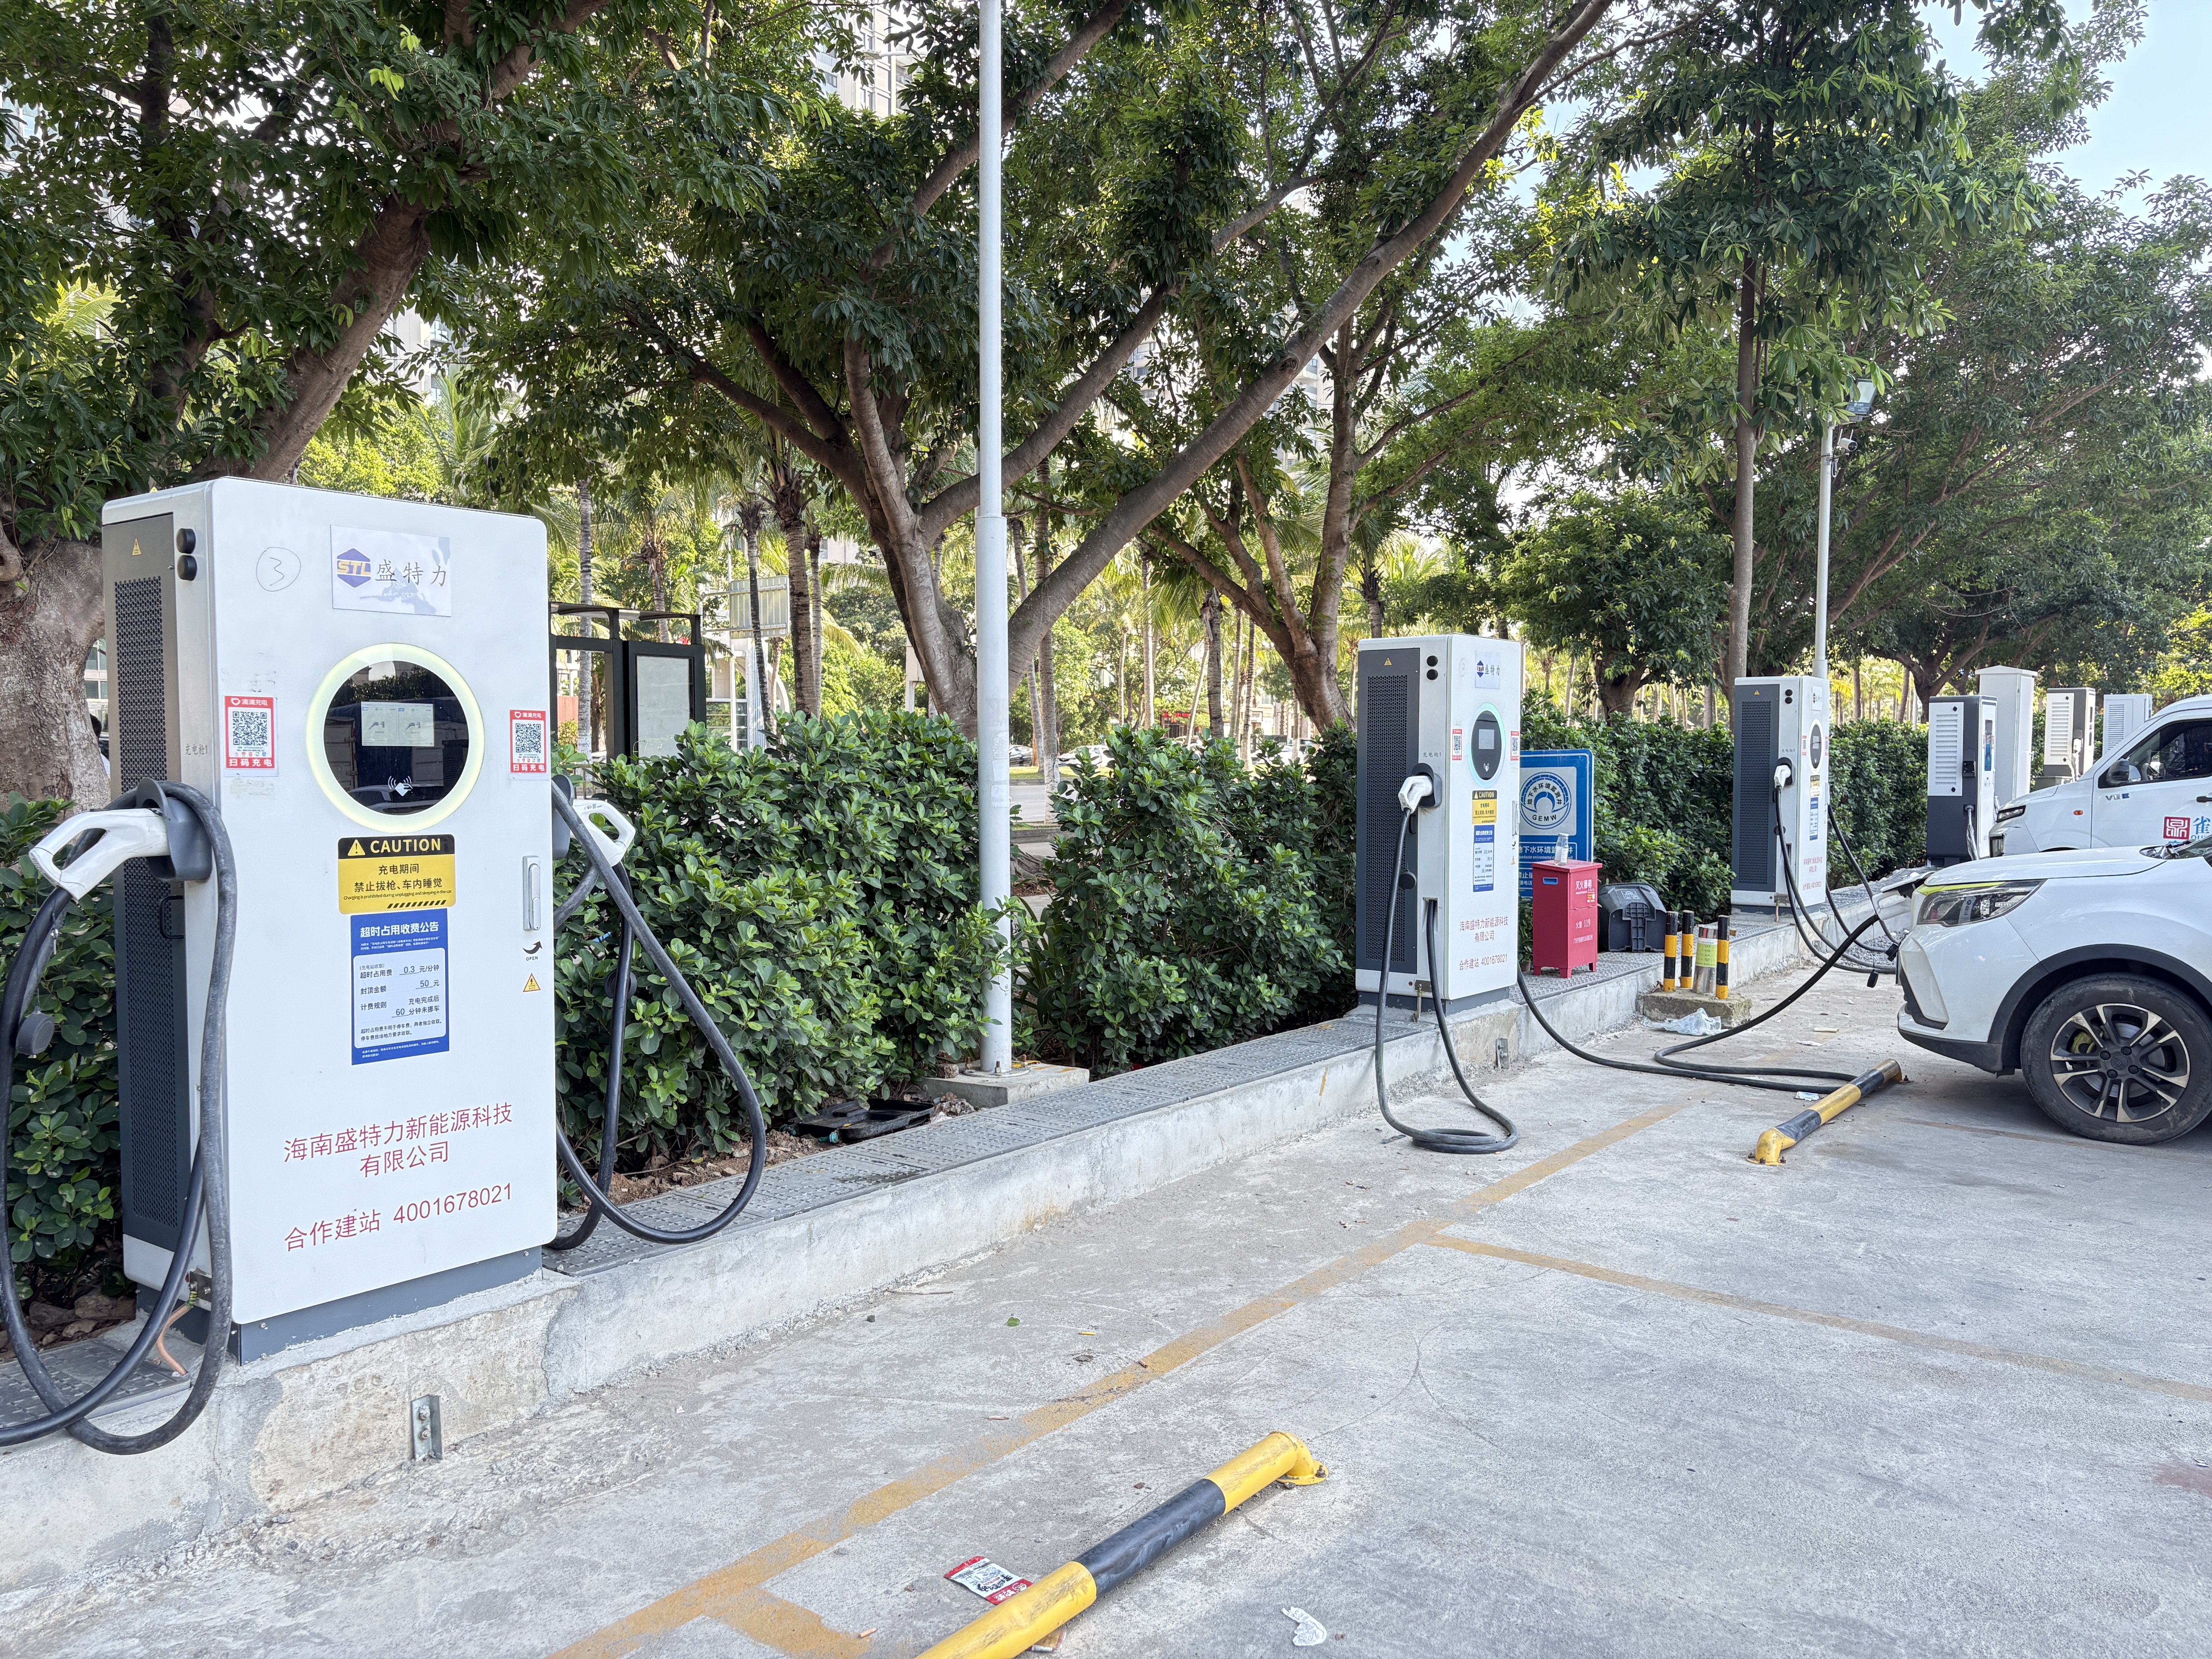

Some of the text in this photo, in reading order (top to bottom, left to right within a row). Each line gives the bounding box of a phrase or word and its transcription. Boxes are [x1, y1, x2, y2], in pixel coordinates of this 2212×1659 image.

[337, 560, 371, 575] STL
[375, 559, 447, 587] 盛特力
[229, 758, 272, 766] 扫码充电
[2193, 816, 2211, 835] 雀
[370, 838, 441, 854] CAUTION
[378, 864, 419, 875] 充电期间
[354, 878, 442, 893] 禁止拔枪、车内睡觉
[360, 921, 439, 938] 超时占用收费公告
[1460, 915, 1508, 931] 海南盛特力新能源科技
[1475, 930, 1494, 943] 有限公司
[1459, 954, 1507, 970] 合作建站 4001678021
[360, 964, 440, 979] 超时占用费 0.3 元/分钟
[361, 985, 386, 995] 封顶金额
[361, 995, 440, 1011] 计费规则 充电完成后
[395, 1005, 440, 1016] 60 分钟未挪车
[284, 1102, 513, 1163] 海南盛特力新能源科技
[359, 1141, 449, 1178] 有限公司
[284, 1183, 511, 1252] 合作建站 4001678021
